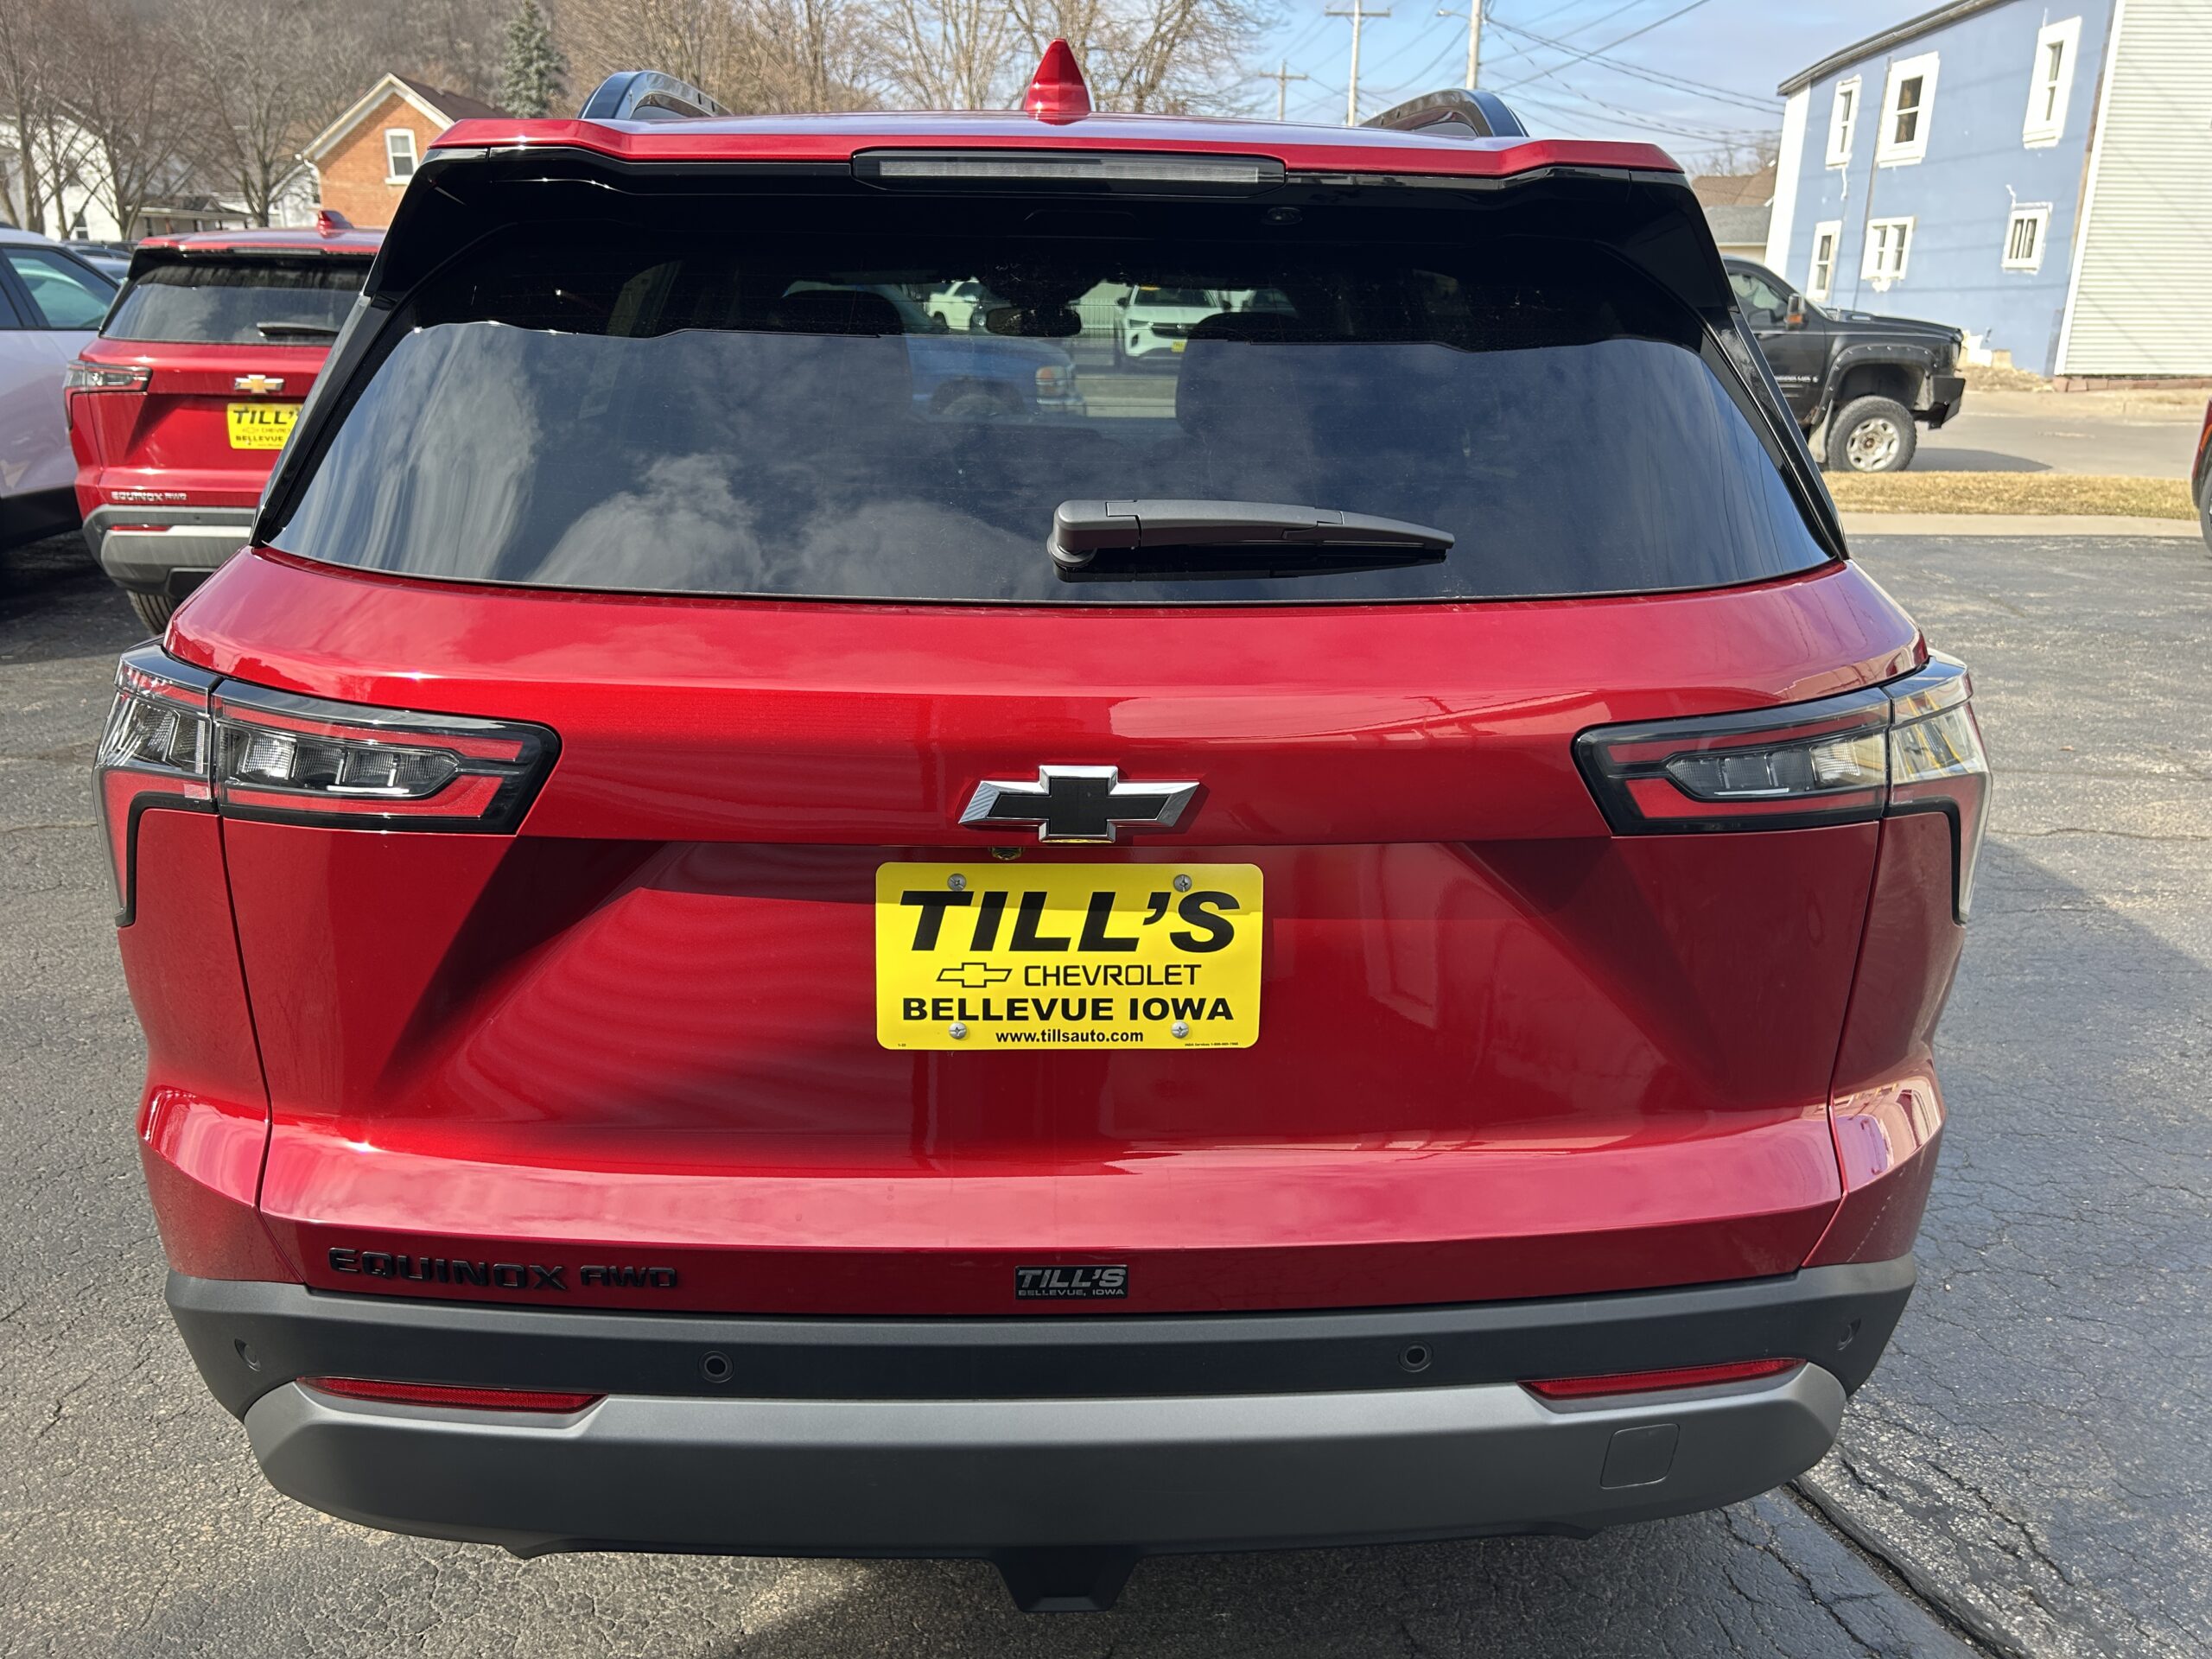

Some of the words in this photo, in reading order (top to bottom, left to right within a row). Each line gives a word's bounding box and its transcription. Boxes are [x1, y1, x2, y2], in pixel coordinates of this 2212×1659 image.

[233, 410, 300, 424] TILL'
[900, 890, 1241, 953] TILL'S
[1024, 963, 1202, 987] CHEVROLET
[902, 997, 1114, 1021] BELLEVUE
[1129, 997, 1235, 1021] IOWA
[995, 1029, 1144, 1043] www.tillsauto.com
[327, 1247, 569, 1291] EQUINOX
[580, 1265, 677, 1288] AWD
[1018, 1268, 1127, 1288] TILL'S
[1018, 1288, 1087, 1297] BELLEVUE,
